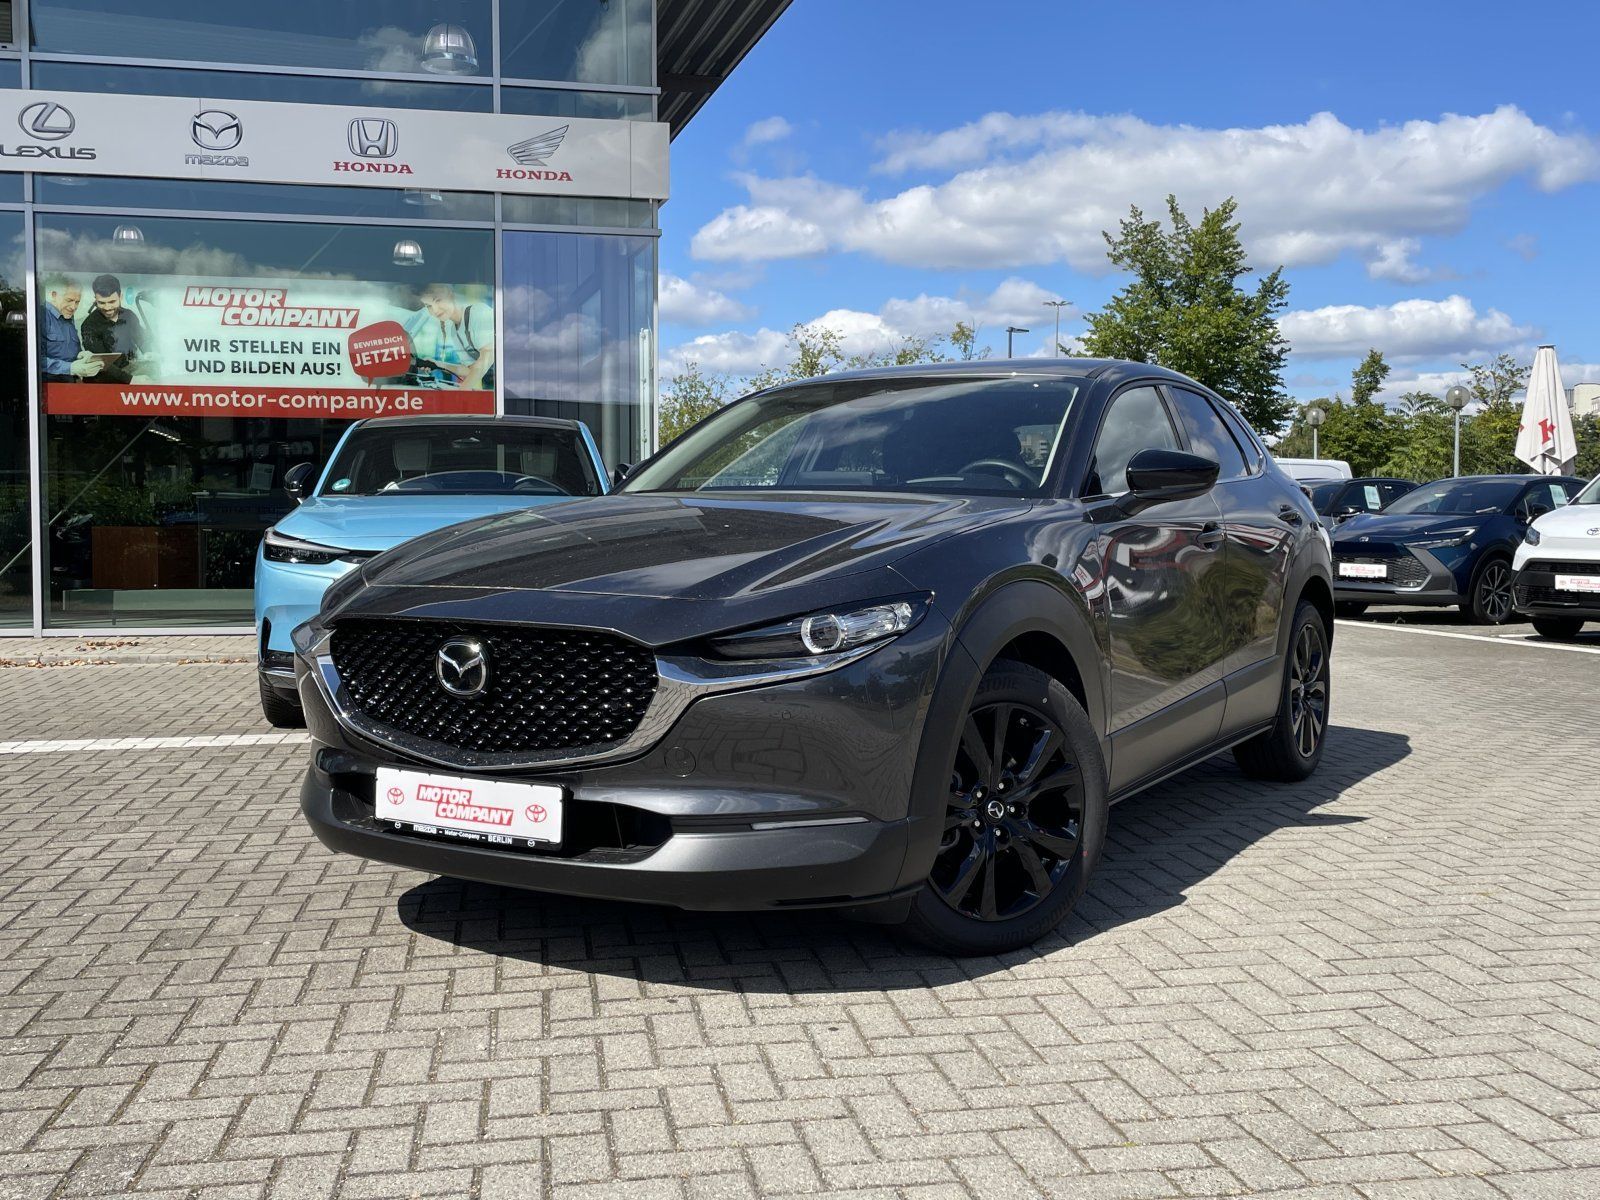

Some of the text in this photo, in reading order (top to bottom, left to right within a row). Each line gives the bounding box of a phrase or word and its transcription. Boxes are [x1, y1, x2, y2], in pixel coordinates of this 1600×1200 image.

[0, 144, 97, 160] LEXUS
[333, 160, 414, 174] HONDA
[496, 167, 573, 181] HONDA
[184, 288, 283, 307] MOTOR
[224, 306, 357, 327] COMPANY
[184, 338, 341, 355] WIR STELLEN EIN
[353, 335, 403, 350] BEWIRB DICH
[354, 346, 406, 367] JETZT!
[185, 359, 341, 376] UND BILDEN AUS!
[120, 389, 424, 414] www.motor-company.de
[419, 786, 470, 804] MOTOR
[437, 803, 513, 824] COMPANY
[487, 835, 513, 844] BERLIN
